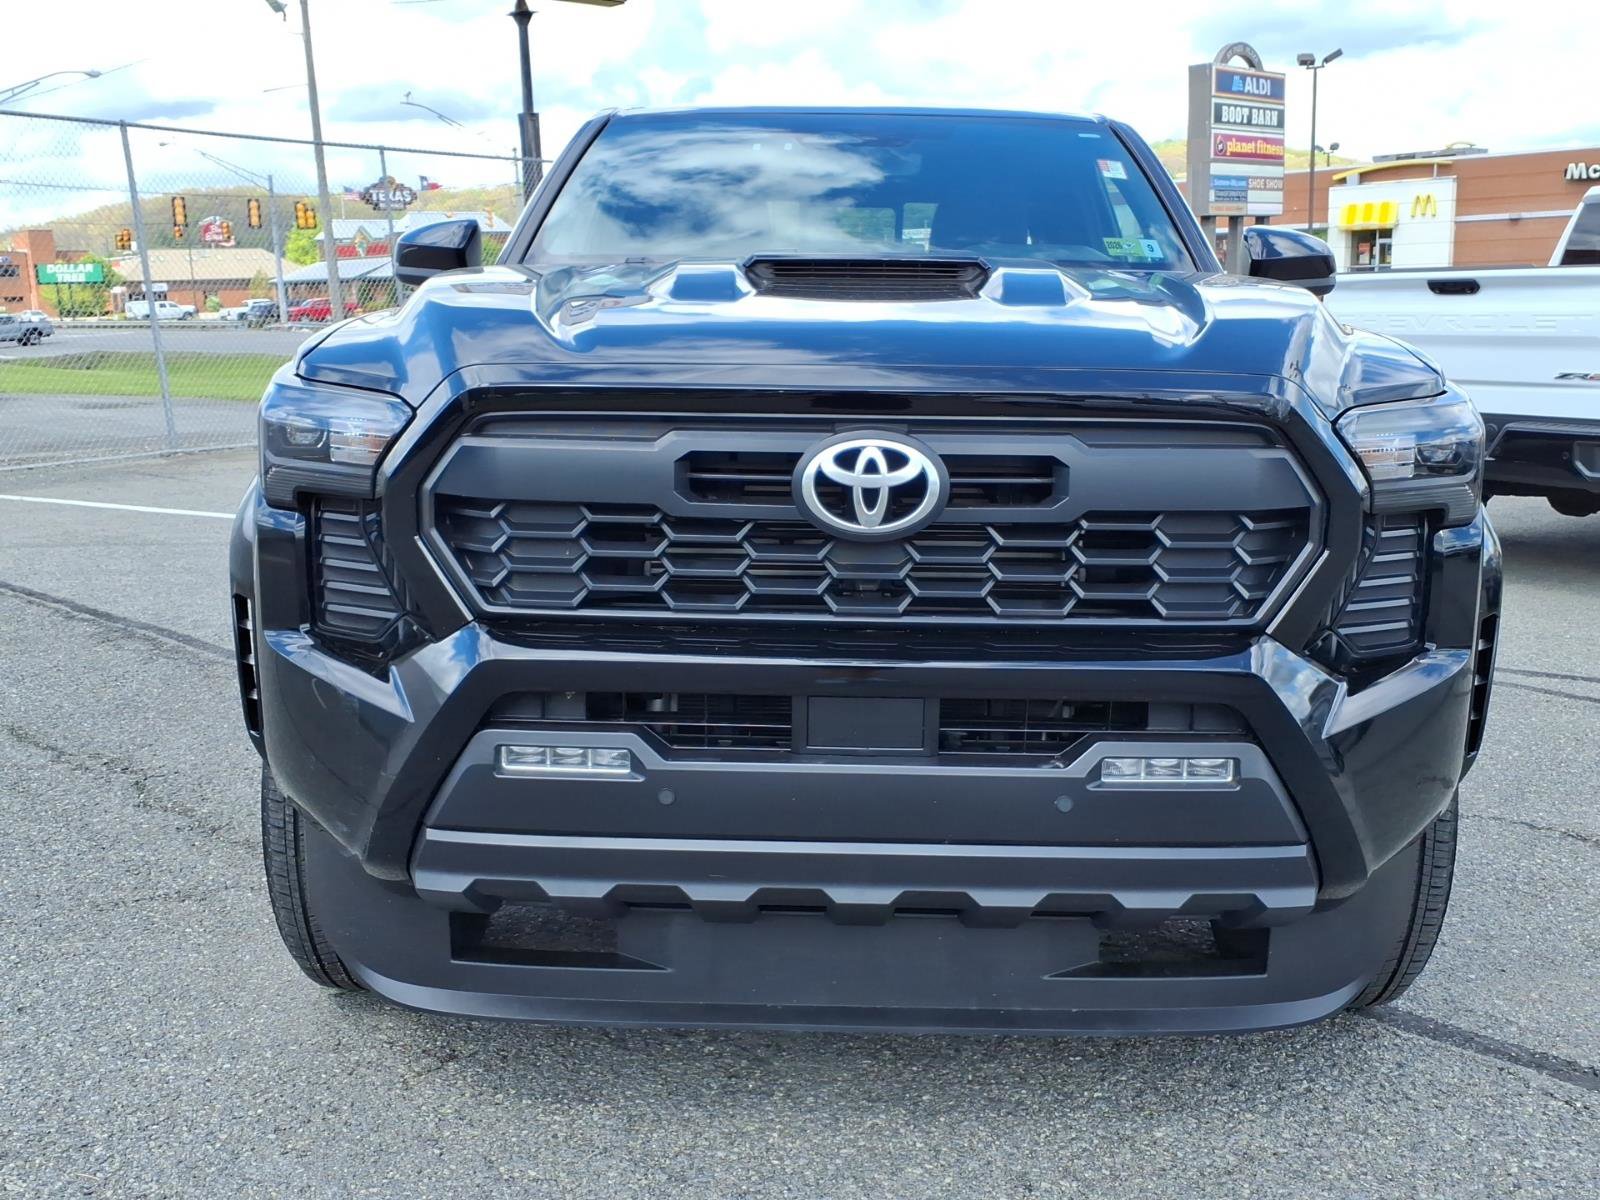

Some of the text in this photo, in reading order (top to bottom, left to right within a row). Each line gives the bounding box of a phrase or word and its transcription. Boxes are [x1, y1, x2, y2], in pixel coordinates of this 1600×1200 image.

[1244, 76, 1271, 96] ALDI
[1221, 105, 1278, 126] BOOT BARN
[1226, 137, 1283, 156] planet fitness
[1248, 178, 1265, 189] SHOE
[46, 263, 94, 273] DOLLAR
[56, 272, 86, 282] TREE
